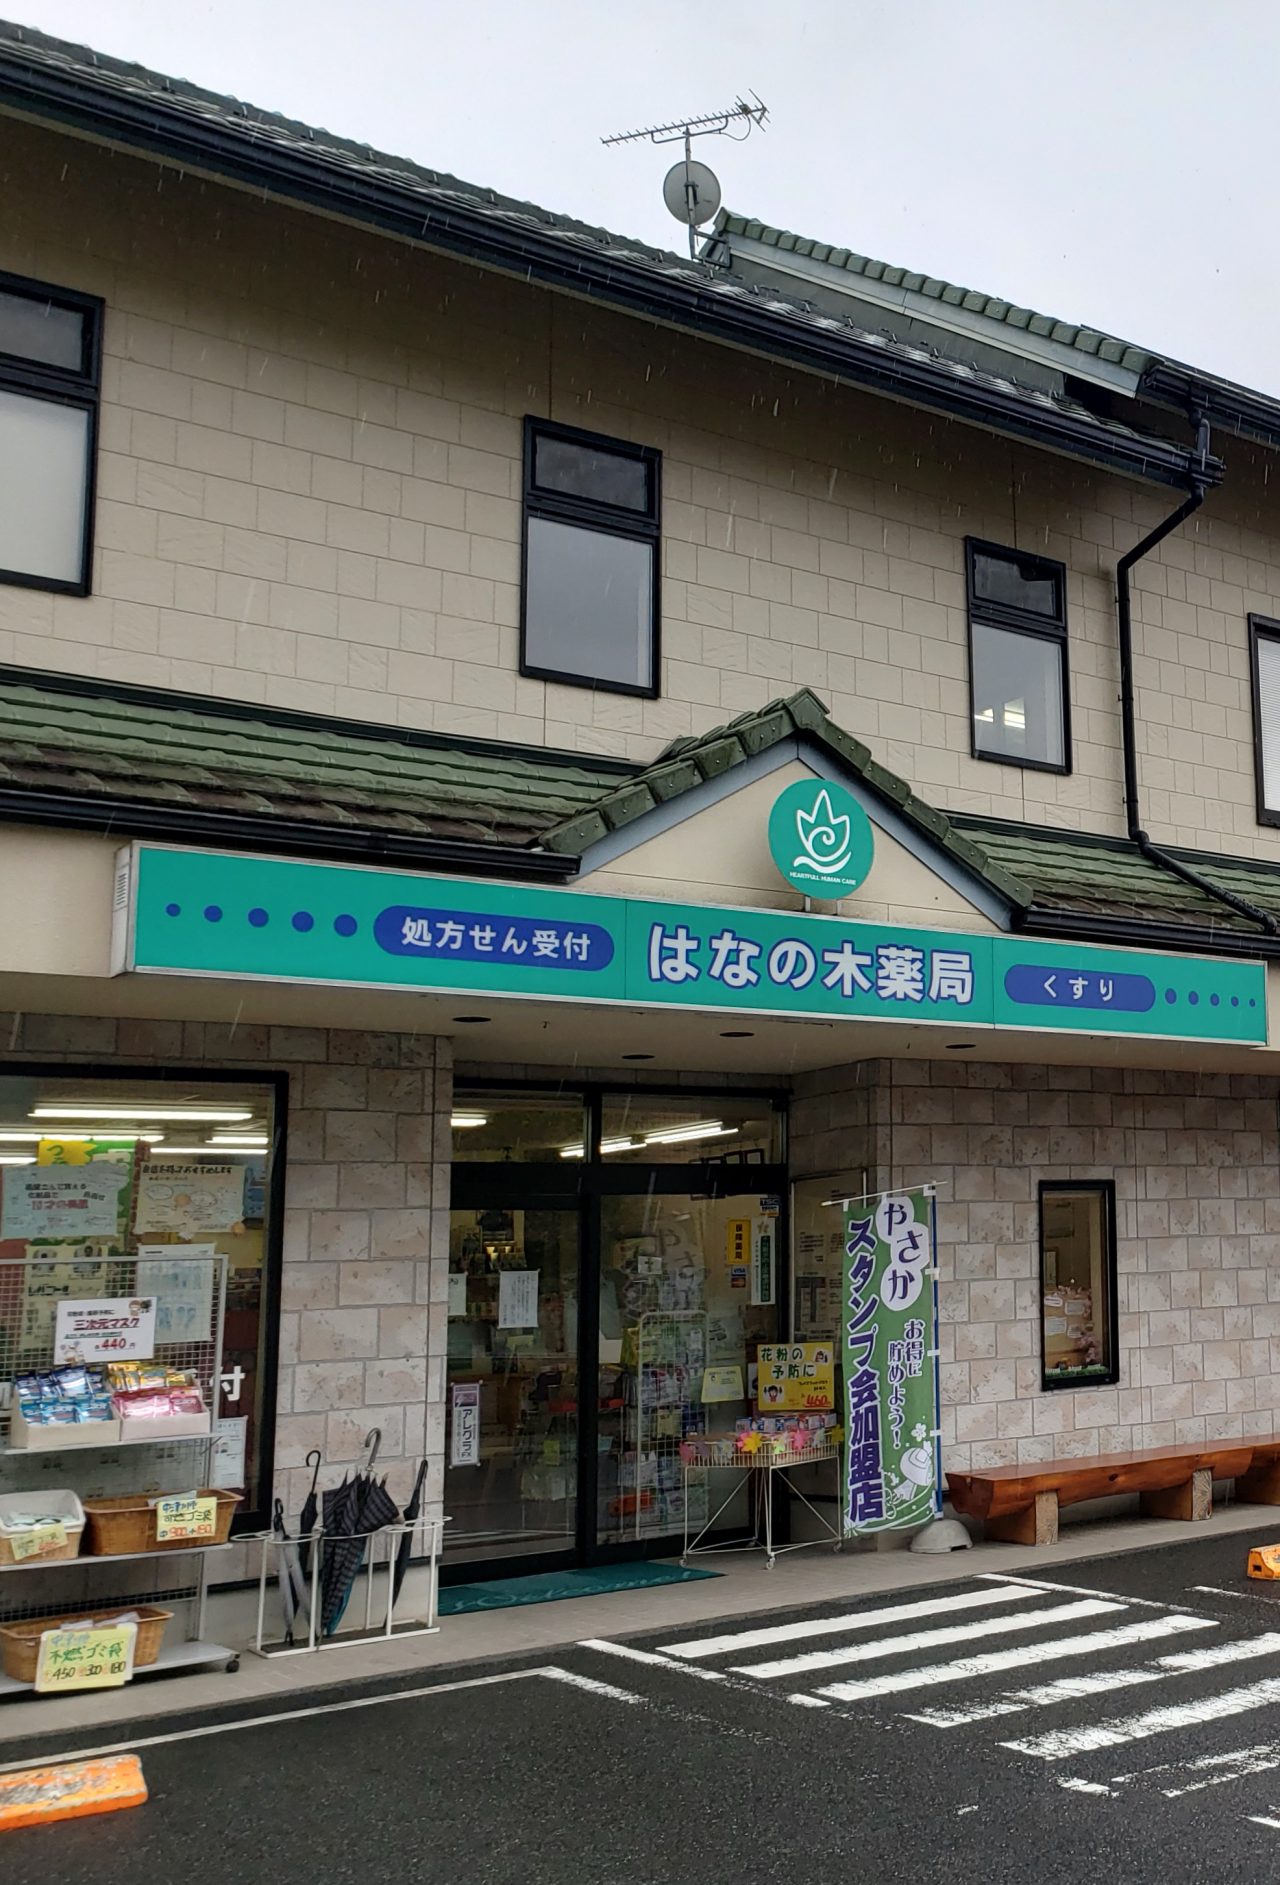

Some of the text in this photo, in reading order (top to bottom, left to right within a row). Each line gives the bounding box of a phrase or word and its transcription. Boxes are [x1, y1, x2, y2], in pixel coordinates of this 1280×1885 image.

[789, 872, 820, 881] HEARTFULL
[401, 915, 591, 961] 処方せん受付
[648, 922, 974, 1006] はなの木薬局
[1042, 974, 1115, 1003] くすり
[884, 1203, 923, 1302] やさか
[74, 1318, 140, 1330] 三次元マスク
[761, 1347, 803, 1362] 花粉の
[905, 1319, 925, 1377] お得に
[772, 1364, 815, 1379] 予防に
[847, 1214, 886, 1524] スタンプ会加盟店
